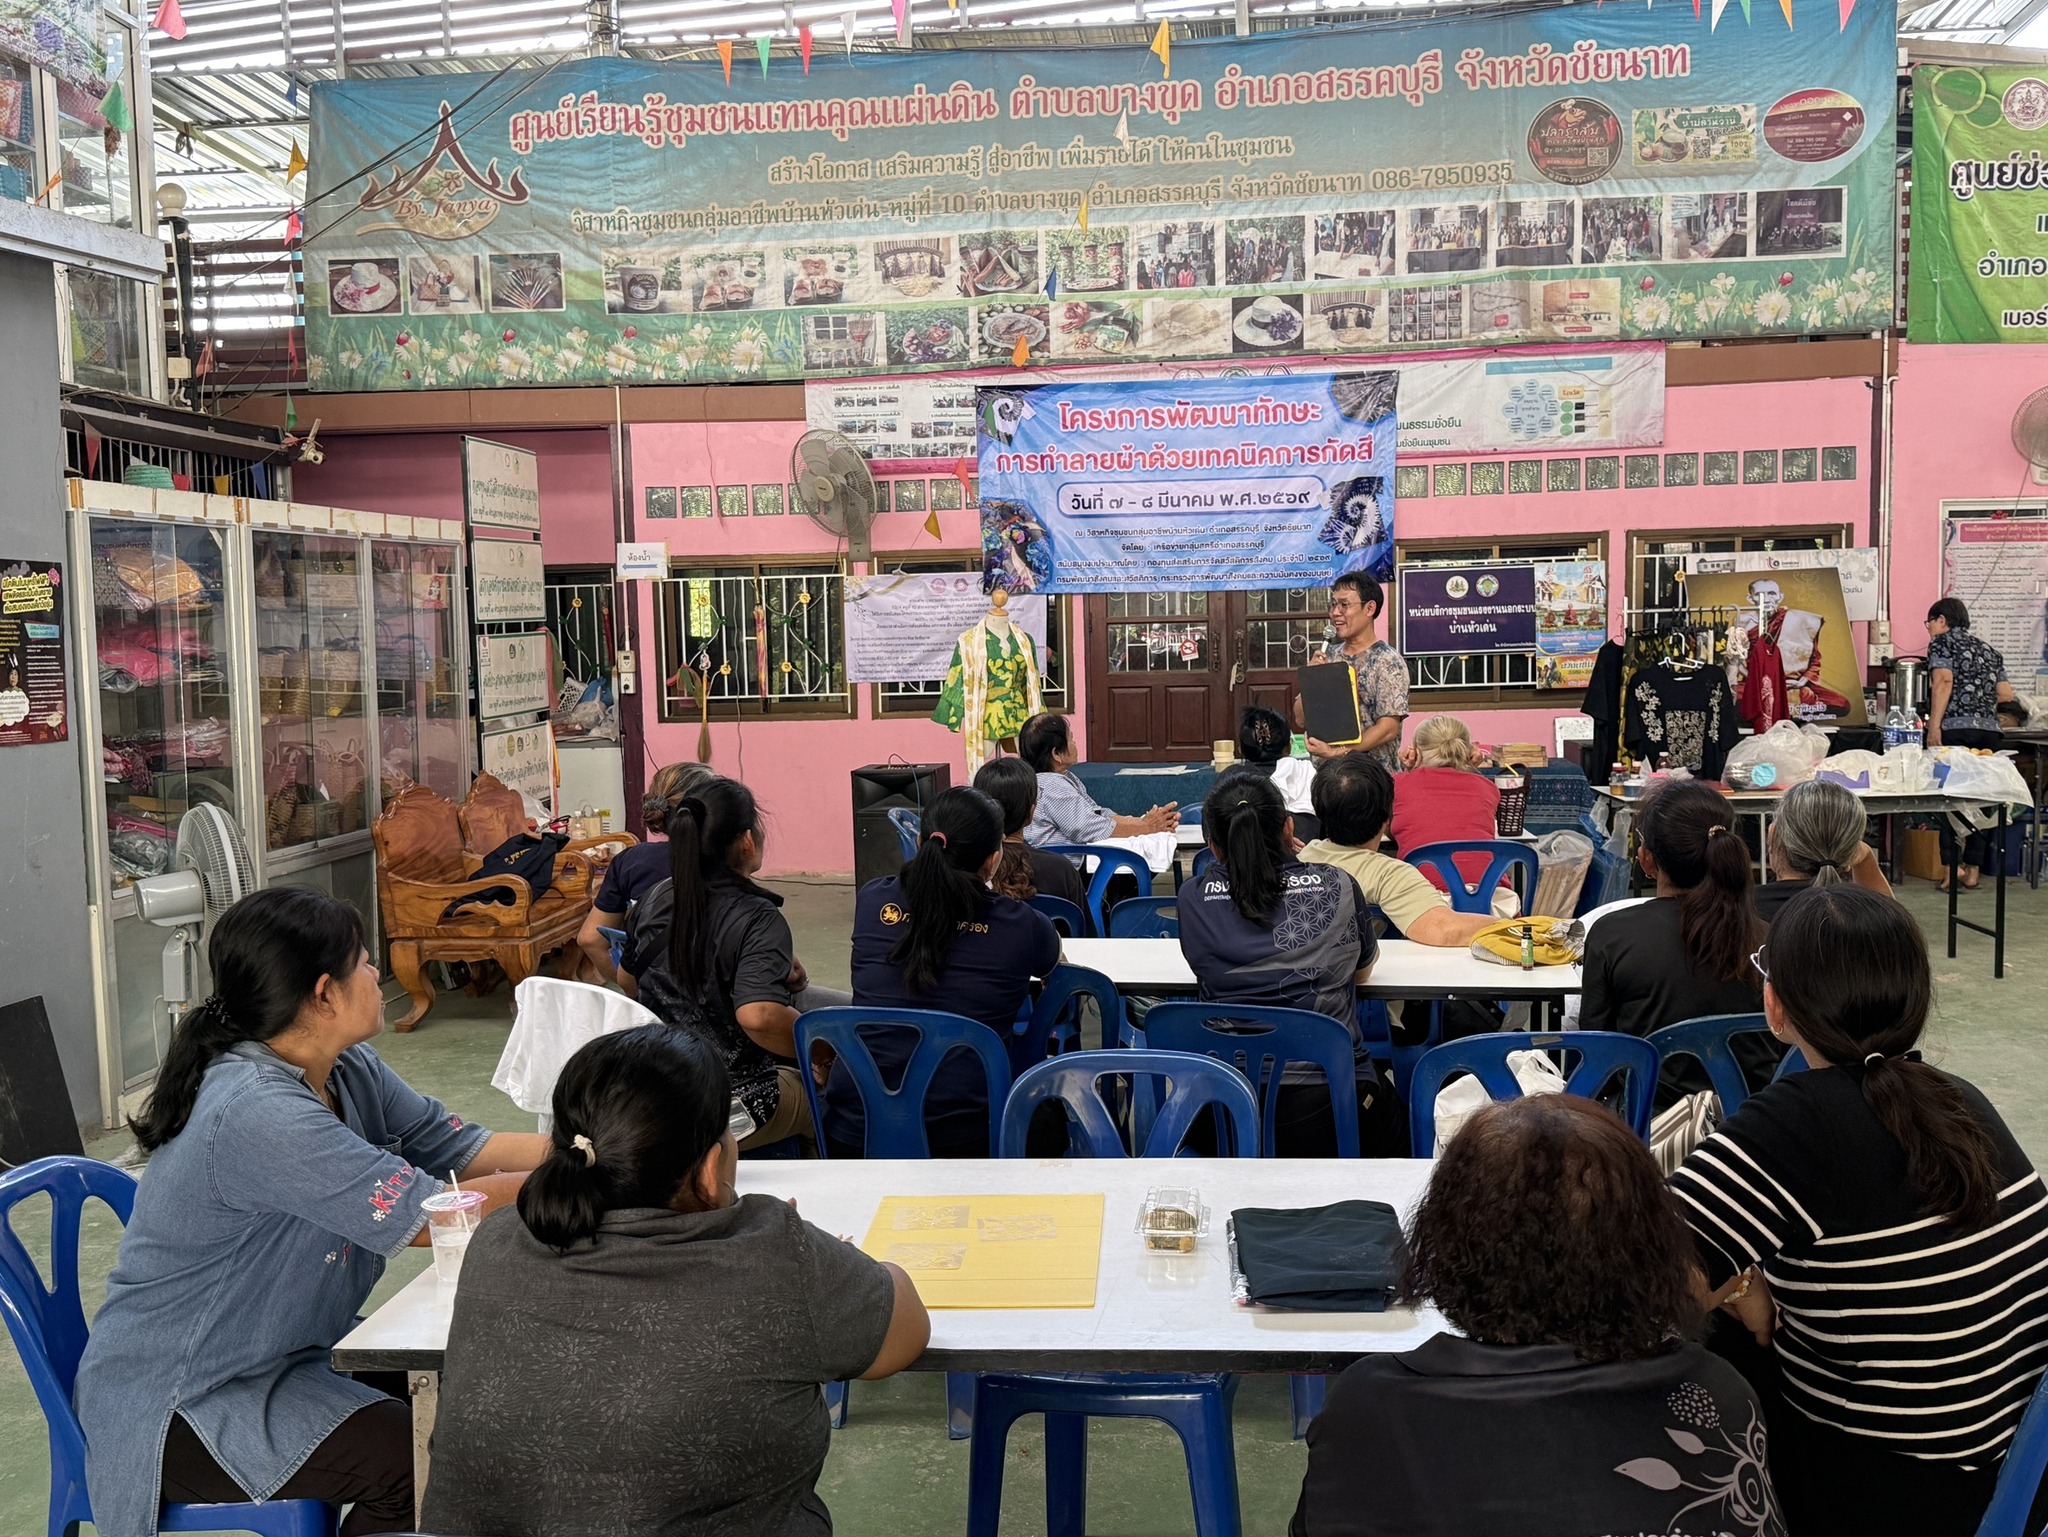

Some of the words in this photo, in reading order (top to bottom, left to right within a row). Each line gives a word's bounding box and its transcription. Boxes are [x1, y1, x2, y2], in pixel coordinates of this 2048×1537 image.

[511, 81, 996, 152] ศูนย์เรียนรู้ชุมชนแทนคุณแผ่นดิน
[1011, 77, 1200, 121] ตำบลบางขุด
[1218, 50, 1442, 106] อำเภอสรรคบุรี
[1457, 42, 1689, 90] จังหวัดชัยนาท
[770, 154, 869, 183] สร้างโอกาส
[879, 145, 980, 178] เสริมความรู้
[988, 143, 1050, 174] สู่อาชีพ
[1060, 137, 1152, 169] เพิ่มรายได้
[1158, 134, 1292, 164] ให้คนในชุมชน
[397, 199, 426, 219] By.
[429, 198, 492, 219] Janya
[572, 200, 880, 237] วิสาหกิจชุมชนกลุ่มอาชีพบ้านหัวเด่น
[890, 187, 932, 224] หมู่ที่
[942, 193, 966, 215] 10
[975, 187, 1082, 216] ตำบลบางขุด
[1092, 179, 1221, 208] อำเภอสรรคบุรี
[1230, 174, 1363, 200] จังหวัดชัยนาท
[1371, 162, 1513, 190] 086-7950935
[1979, 252, 2048, 276] อำเภอ
[1059, 397, 1322, 432] โครงการพัฒนาทักษะ
[996, 434, 1374, 473] การทำลายผ้าด้วยเทคนิคการกัดสี
[1071, 487, 1104, 510] วันที่
[1108, 497, 1124, 509] ๗
[1141, 495, 1154, 508] ๘
[1159, 490, 1215, 508] มีนาคม
[1220, 489, 1312, 507] พ.ศ.๒๕๖๙
[1075, 528, 1084, 538] ณ
[1210, 523, 1261, 537] อำเภอสรรคบุรี
[1264, 521, 1312, 533] จังหวัดชัยนาท
[627, 550, 651, 562] ห้องน้ำ
[1121, 541, 1144, 553] จัดโดย
[1449, 620, 1498, 634] บ้านหัวเด่น
